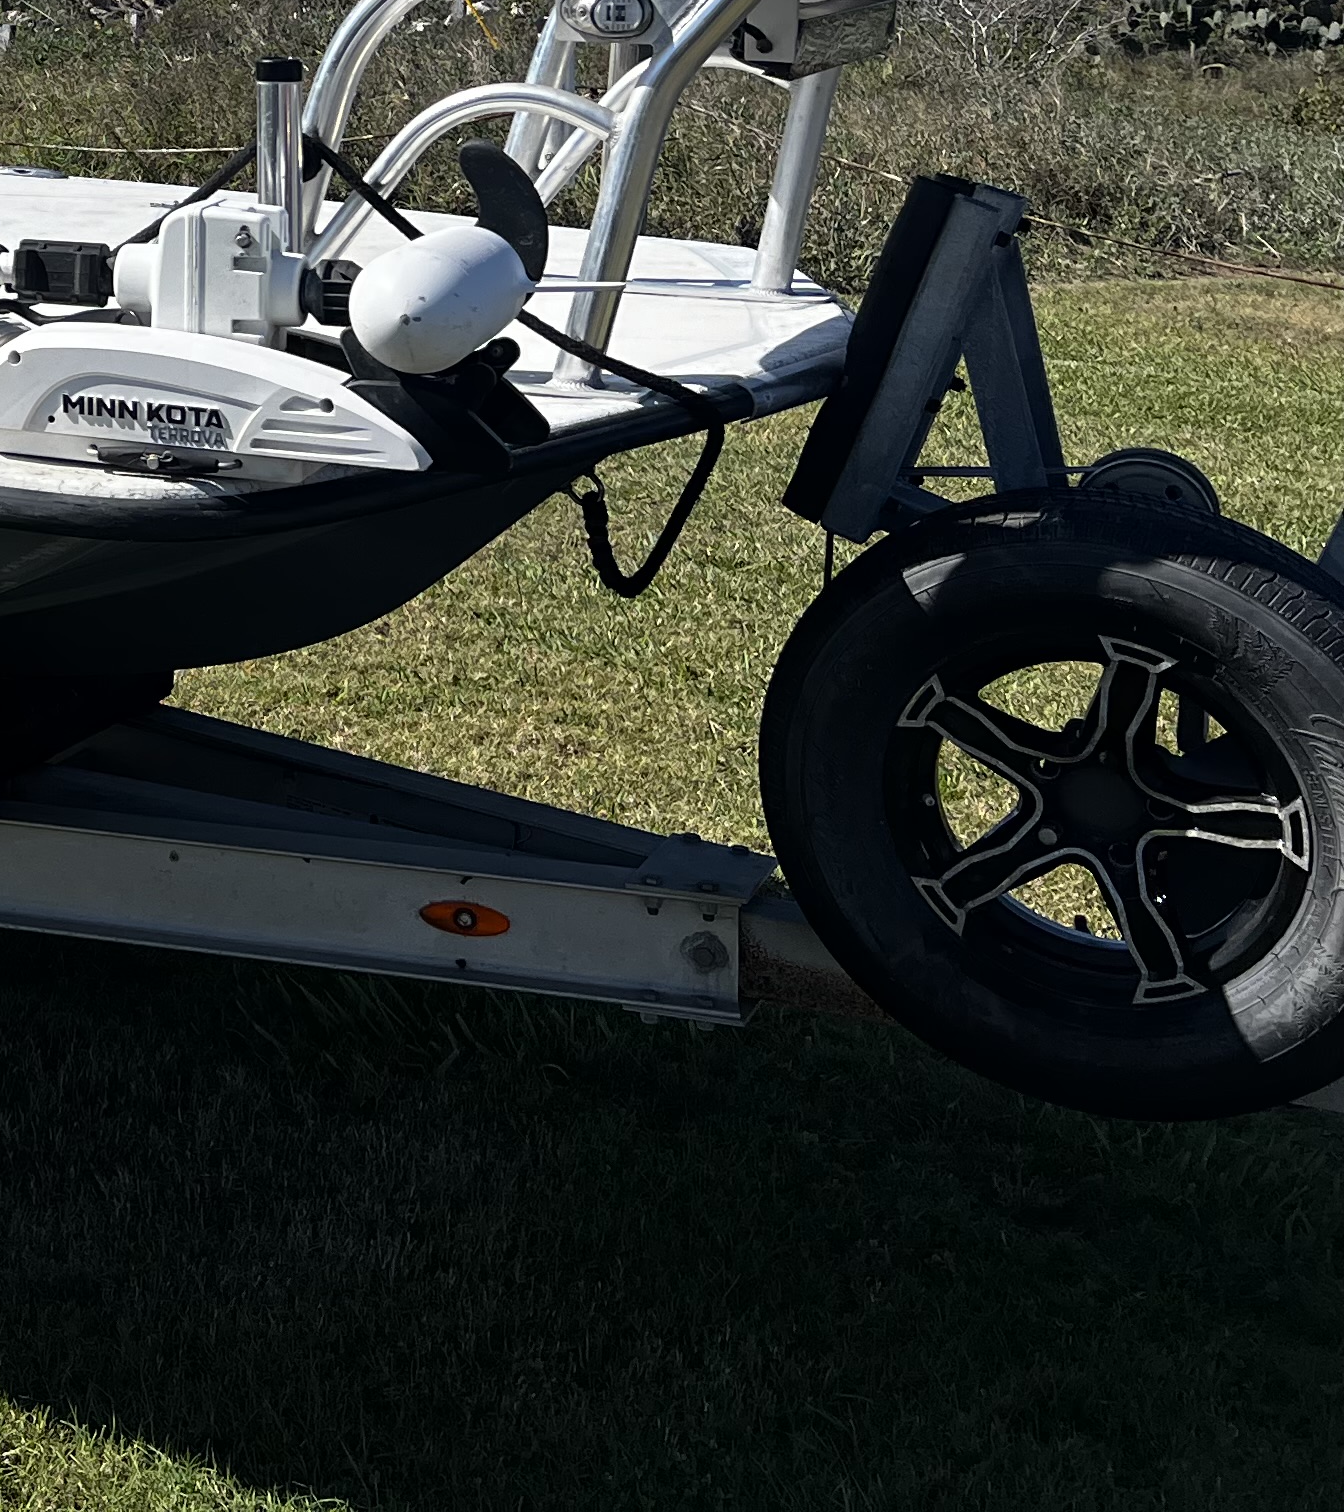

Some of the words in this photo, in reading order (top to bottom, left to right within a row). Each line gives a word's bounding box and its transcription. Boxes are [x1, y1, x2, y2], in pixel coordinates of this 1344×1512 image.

[62, 392, 140, 422] MINN
[146, 401, 225, 429] KOTA
[148, 424, 229, 449] TERROVA
